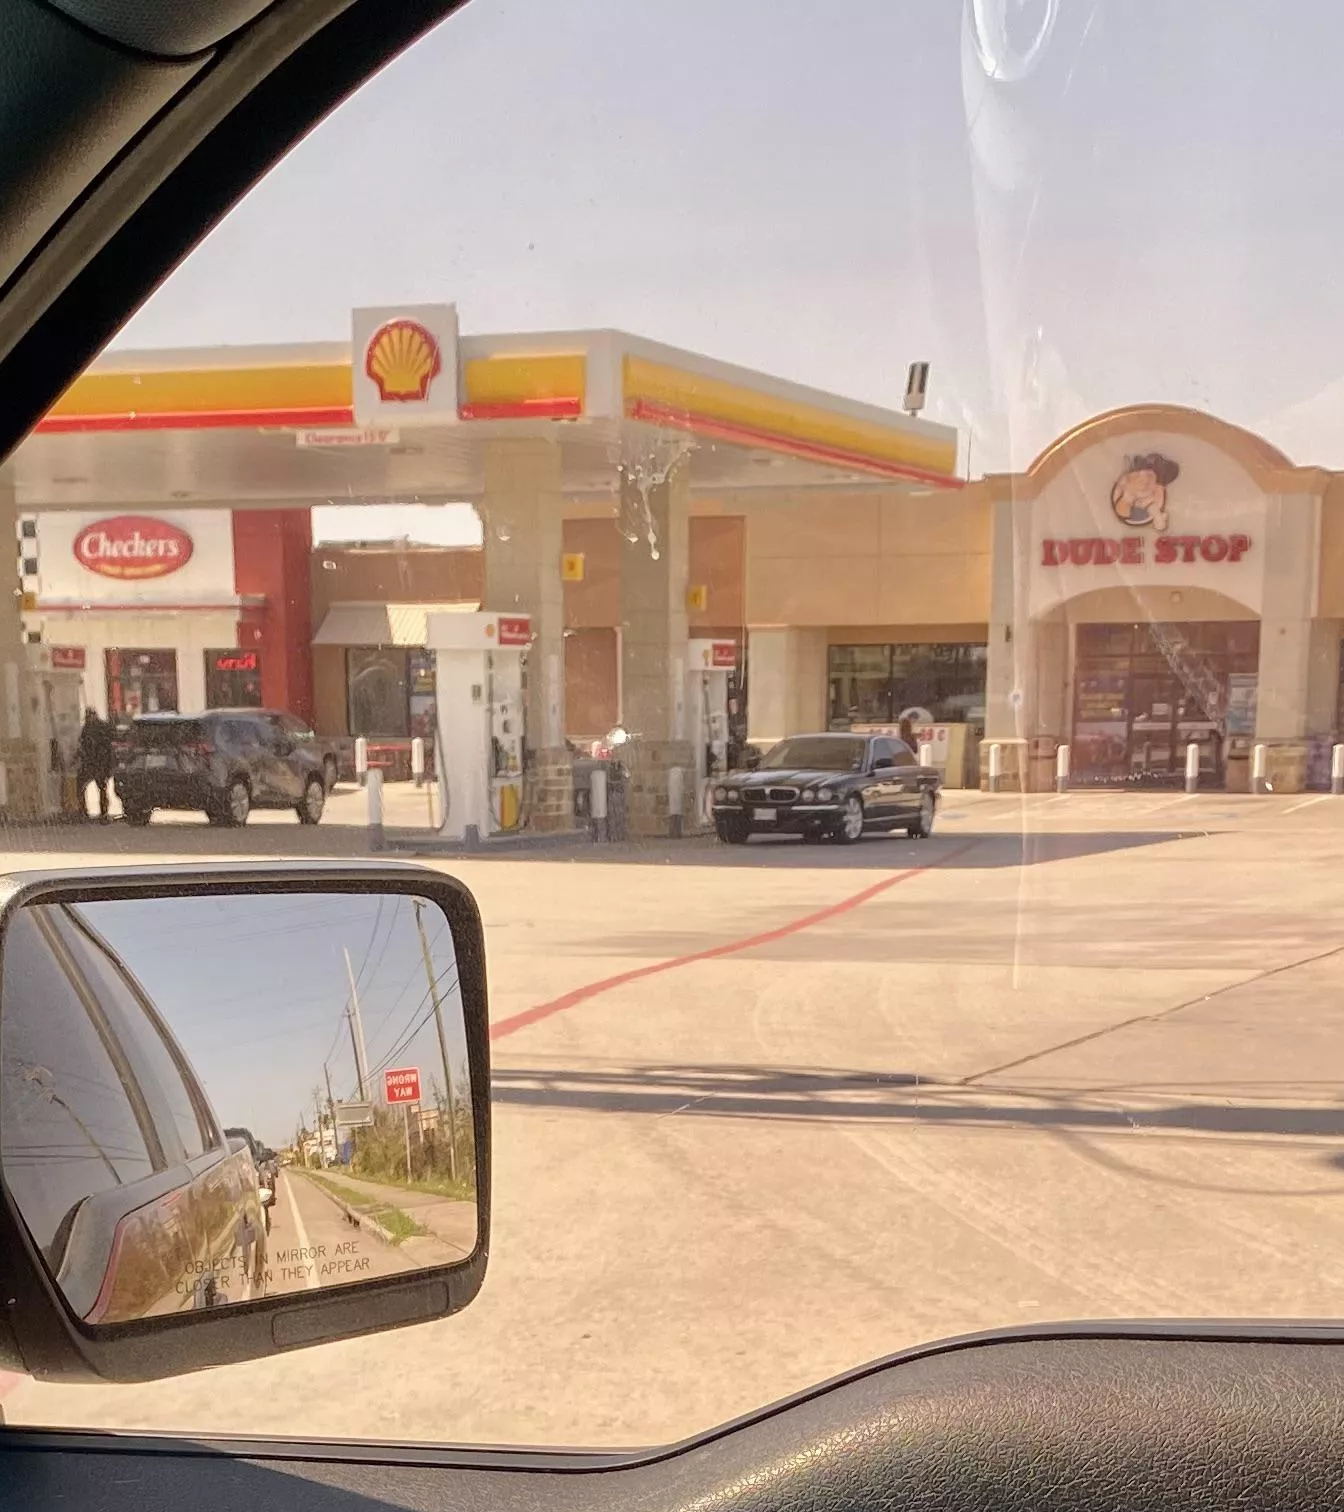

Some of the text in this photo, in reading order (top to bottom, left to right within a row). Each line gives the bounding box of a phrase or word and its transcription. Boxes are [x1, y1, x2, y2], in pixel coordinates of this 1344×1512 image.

[80, 531, 180, 560] Checkers
[1041, 534, 1252, 566] DUDE STOP
[185, 1256, 248, 1274] OBJECTS
[276, 1245, 326, 1264] MIRROR
[335, 1241, 360, 1256] ARE
[176, 1257, 370, 1294] CLOSER THAN THEY APPEAR
